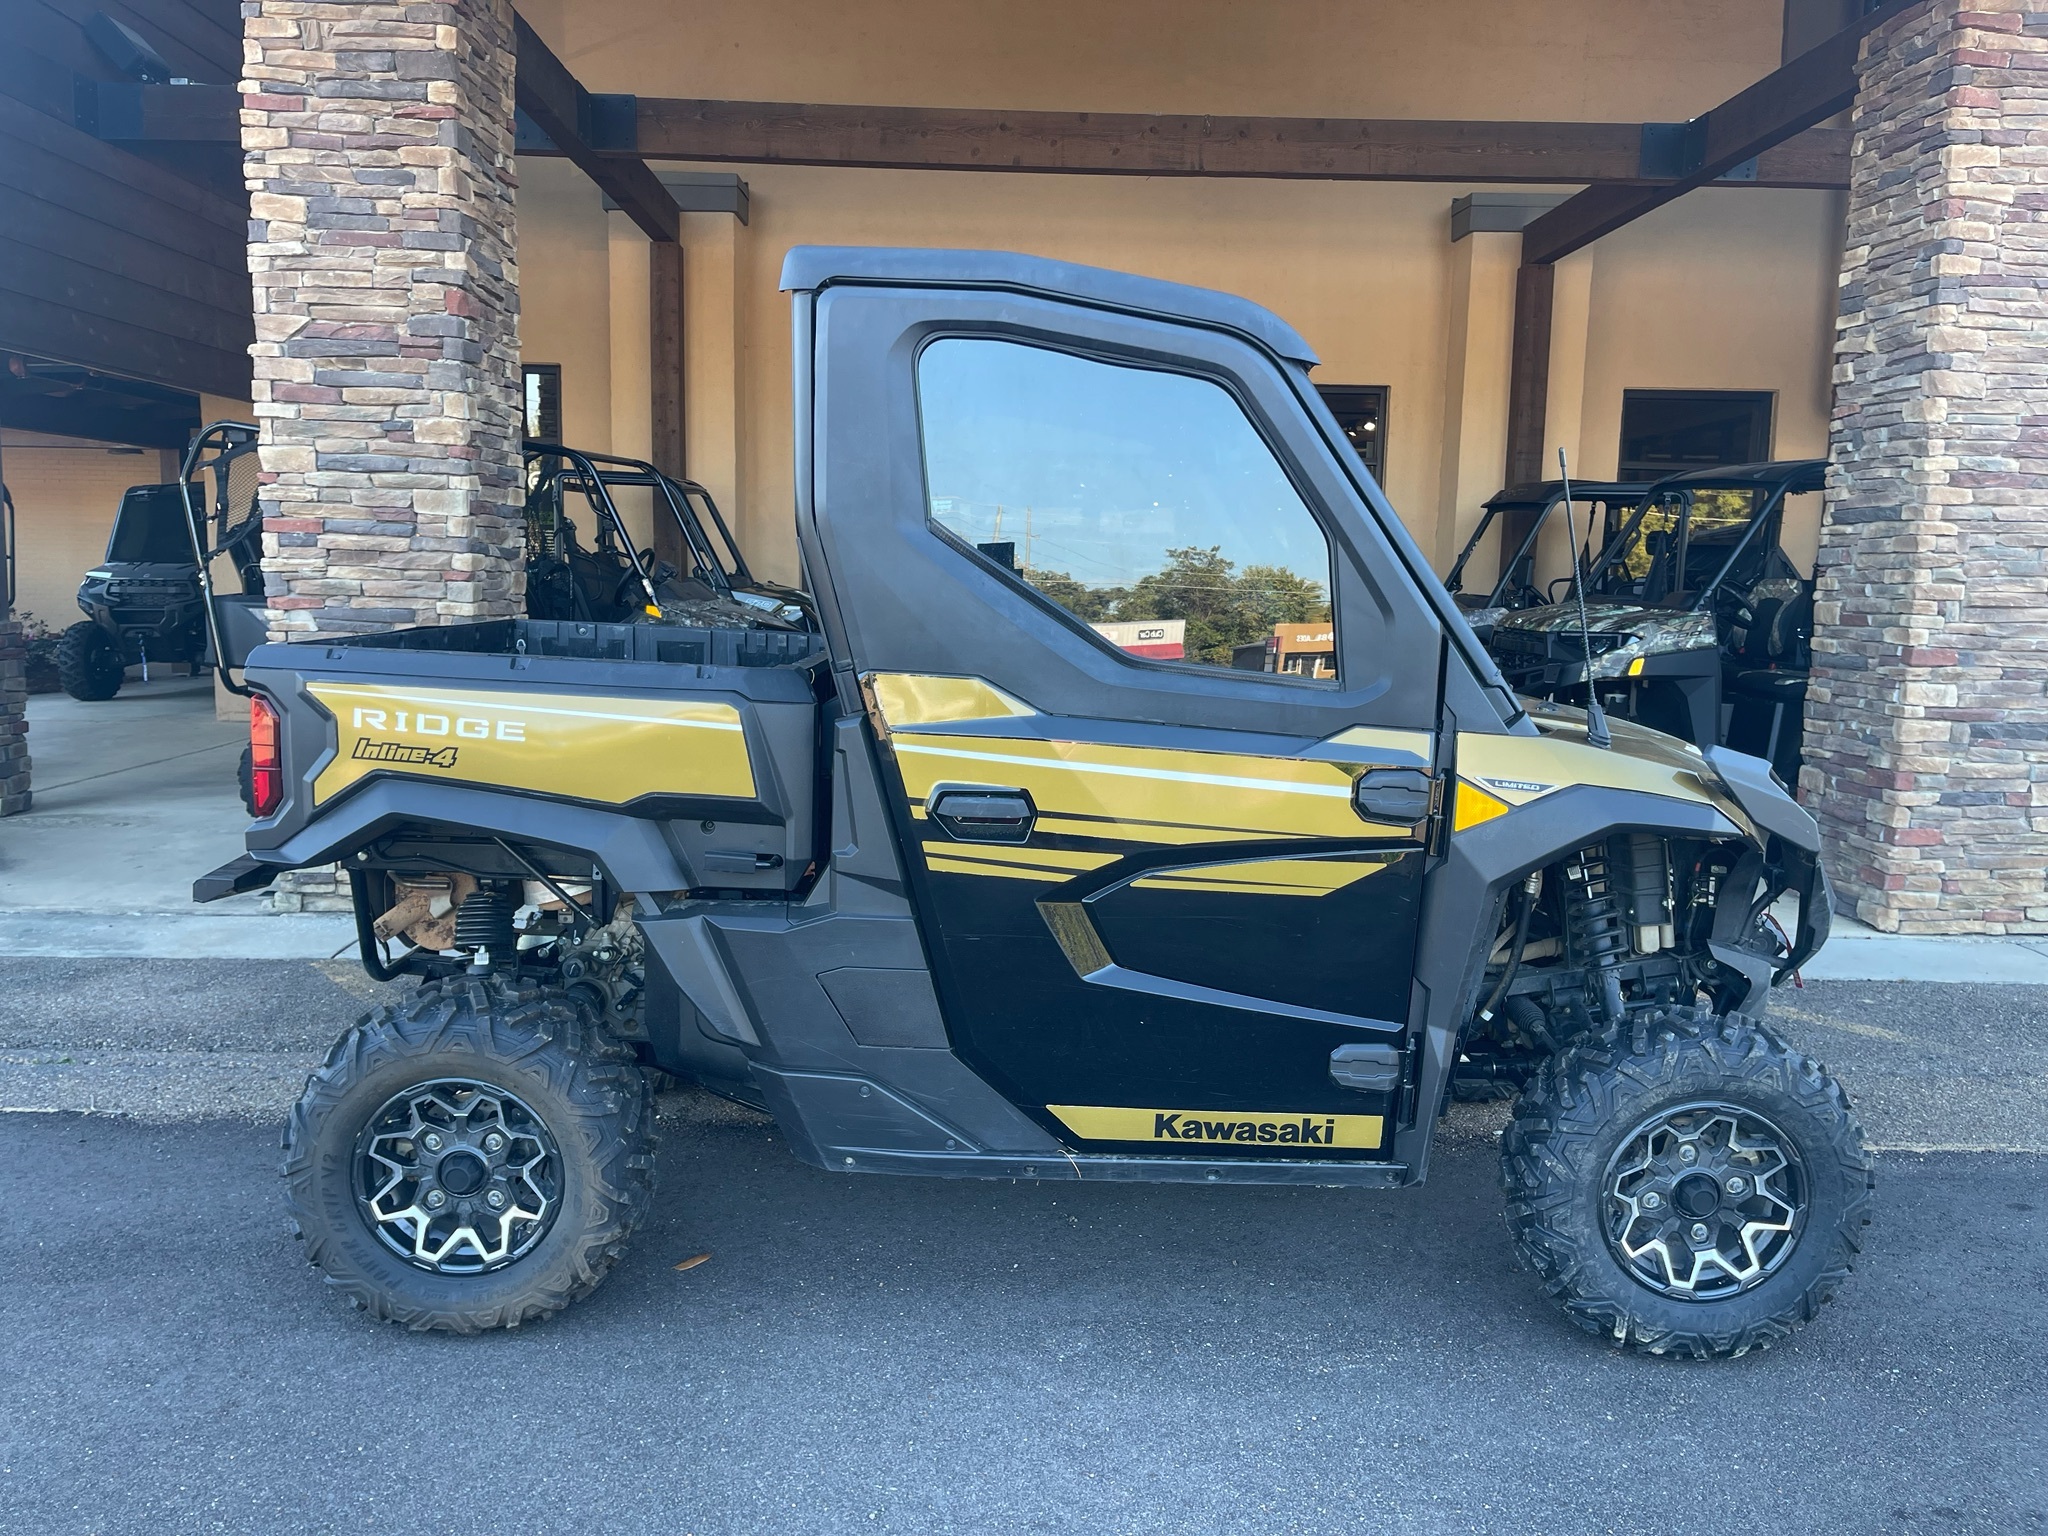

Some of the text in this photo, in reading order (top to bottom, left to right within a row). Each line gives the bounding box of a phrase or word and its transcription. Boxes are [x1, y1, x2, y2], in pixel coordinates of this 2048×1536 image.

[1655, 619, 1710, 635] XP
[1660, 630, 1703, 641] 1000
[352, 707, 527, 742] RIDGE
[351, 737, 459, 769] Inline-4
[1494, 780, 1540, 791] LIMITED
[1154, 1113, 1335, 1145] Kawasaki
[320, 1153, 405, 1291] POWER GRIP V2
